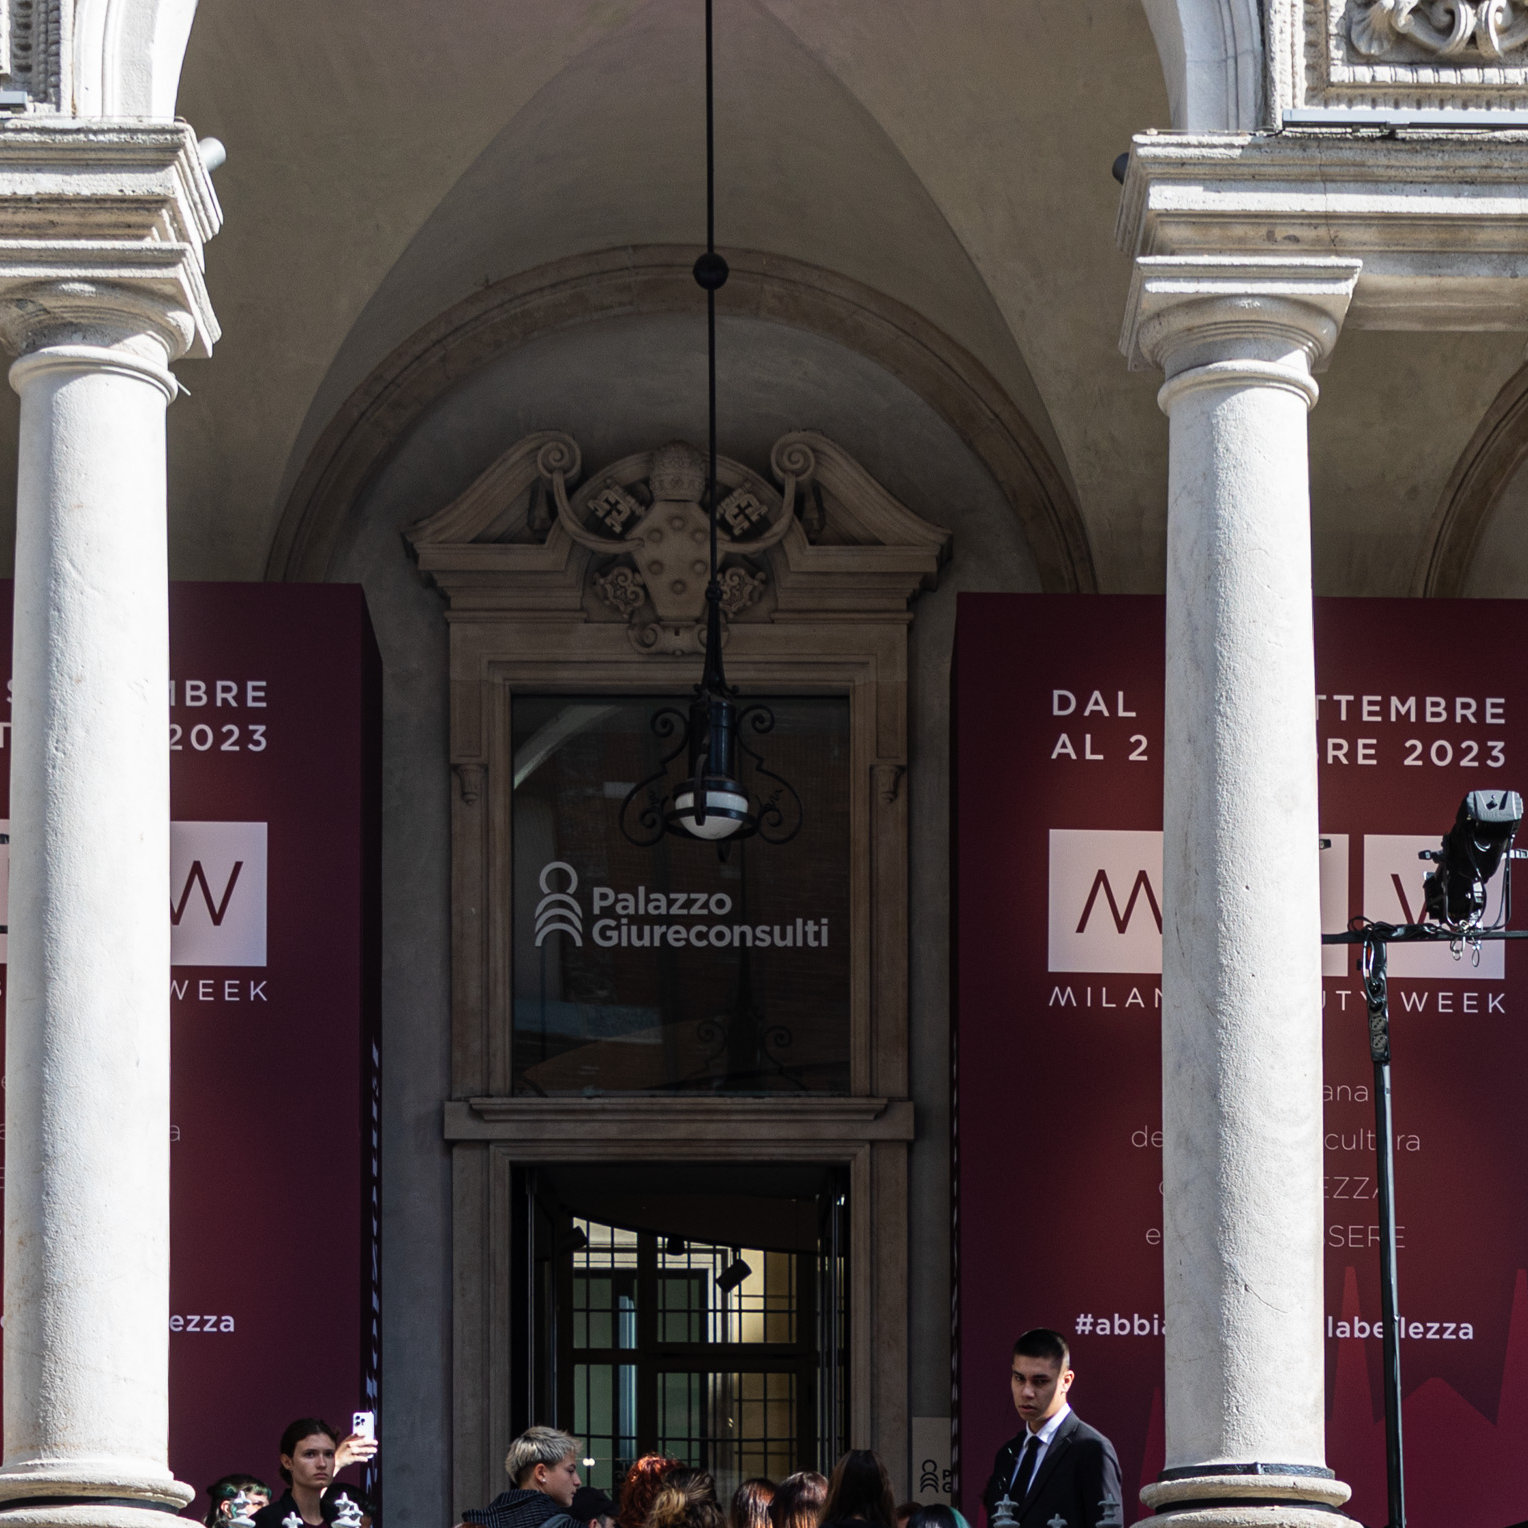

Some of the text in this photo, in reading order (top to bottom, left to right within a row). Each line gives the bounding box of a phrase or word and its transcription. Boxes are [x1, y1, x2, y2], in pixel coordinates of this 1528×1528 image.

[1053, 690, 1505, 724] DAL TTEMBRE
[170, 724, 267, 752] 2023
[1051, 733, 1104, 760] AL
[1129, 734, 1148, 760] 2
[1404, 739, 1505, 767] 2023
[592, 886, 732, 915] Palazzo
[592, 918, 829, 947] Giureconsulti
[1049, 986, 1505, 1013] MILA WEEK
[1324, 1128, 1420, 1151] cultra
[1146, 1228, 1161, 1245] e
